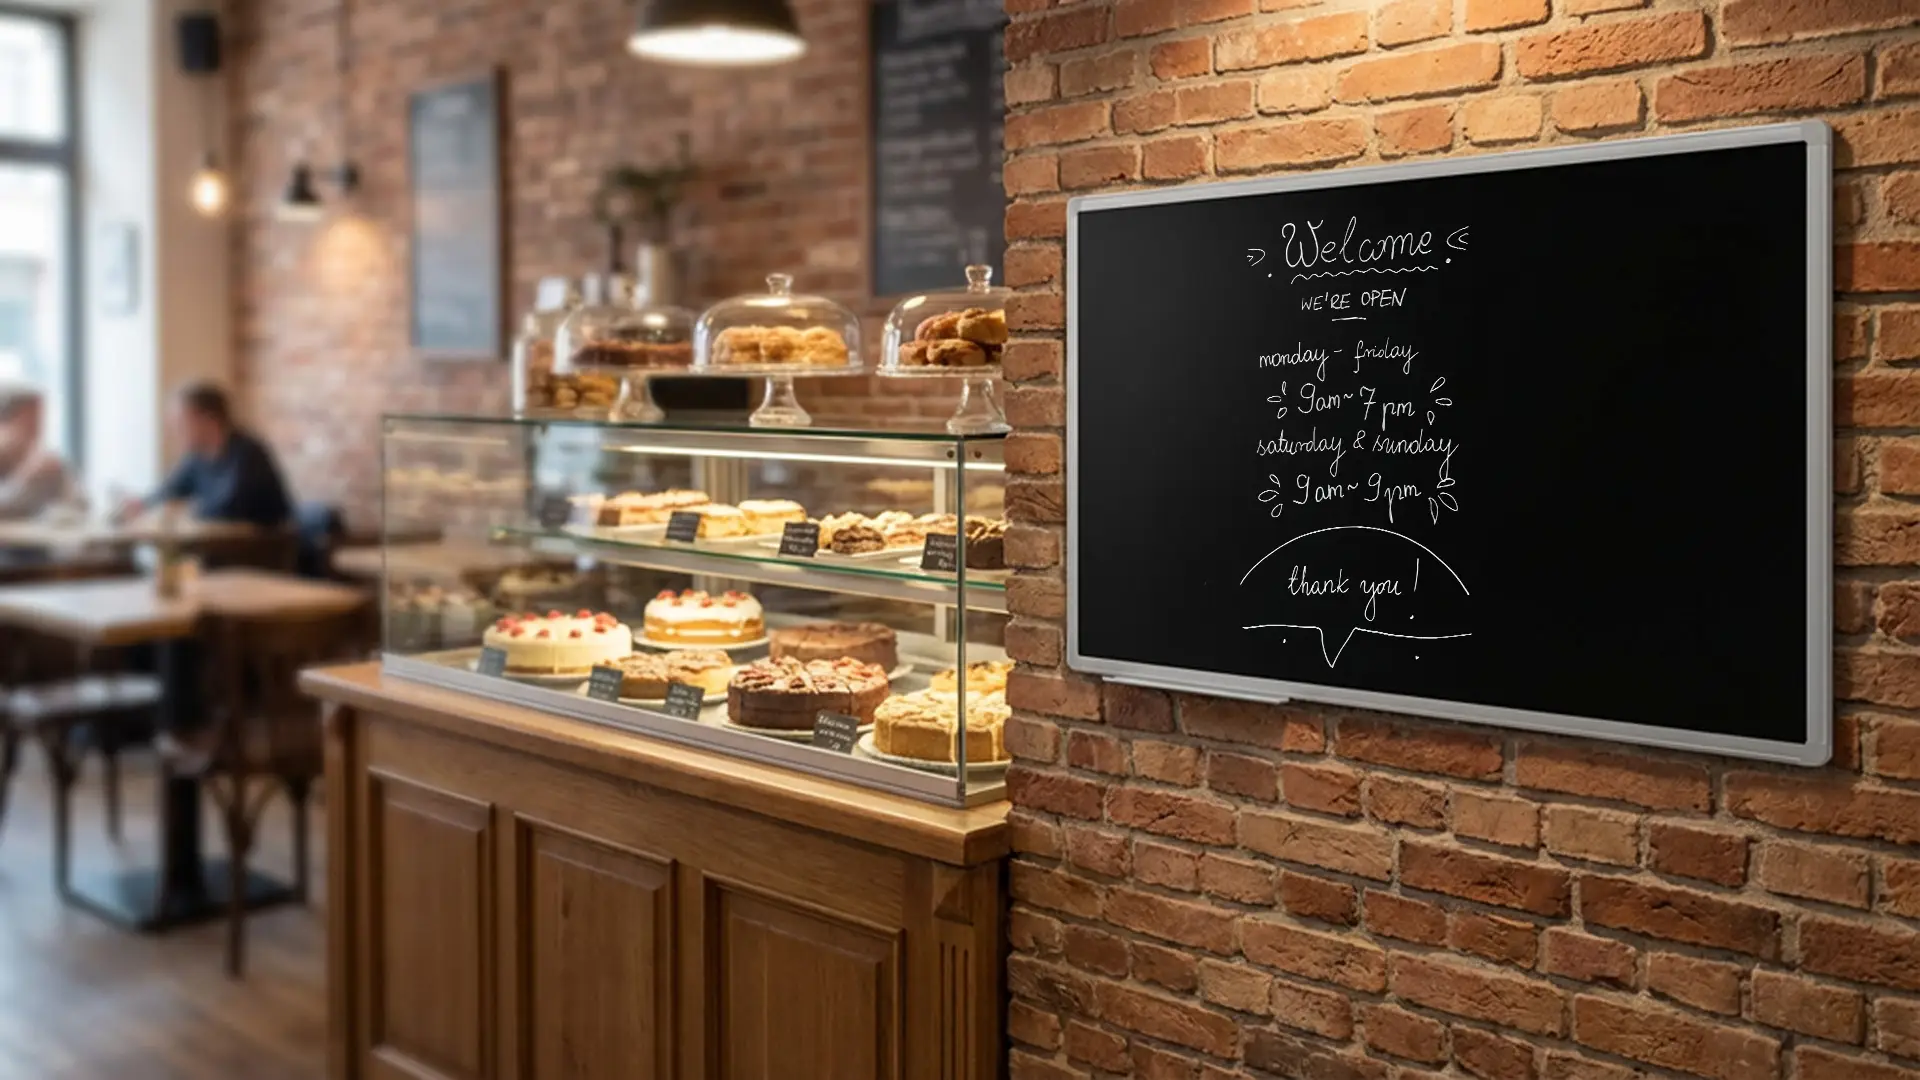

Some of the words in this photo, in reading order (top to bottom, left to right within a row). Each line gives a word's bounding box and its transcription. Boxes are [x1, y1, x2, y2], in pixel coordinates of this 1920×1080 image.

[1281, 216, 1433, 268] Welcome
[1301, 291, 1351, 311] WE'RE
[1361, 288, 1408, 308] OPEN
[1259, 341, 1330, 382] monday
[1353, 337, 1420, 375] friday
[1256, 427, 1347, 478] saturday
[1353, 429, 1366, 450] &
[1372, 429, 1460, 482] sunday
[1287, 564, 1350, 596] thank
